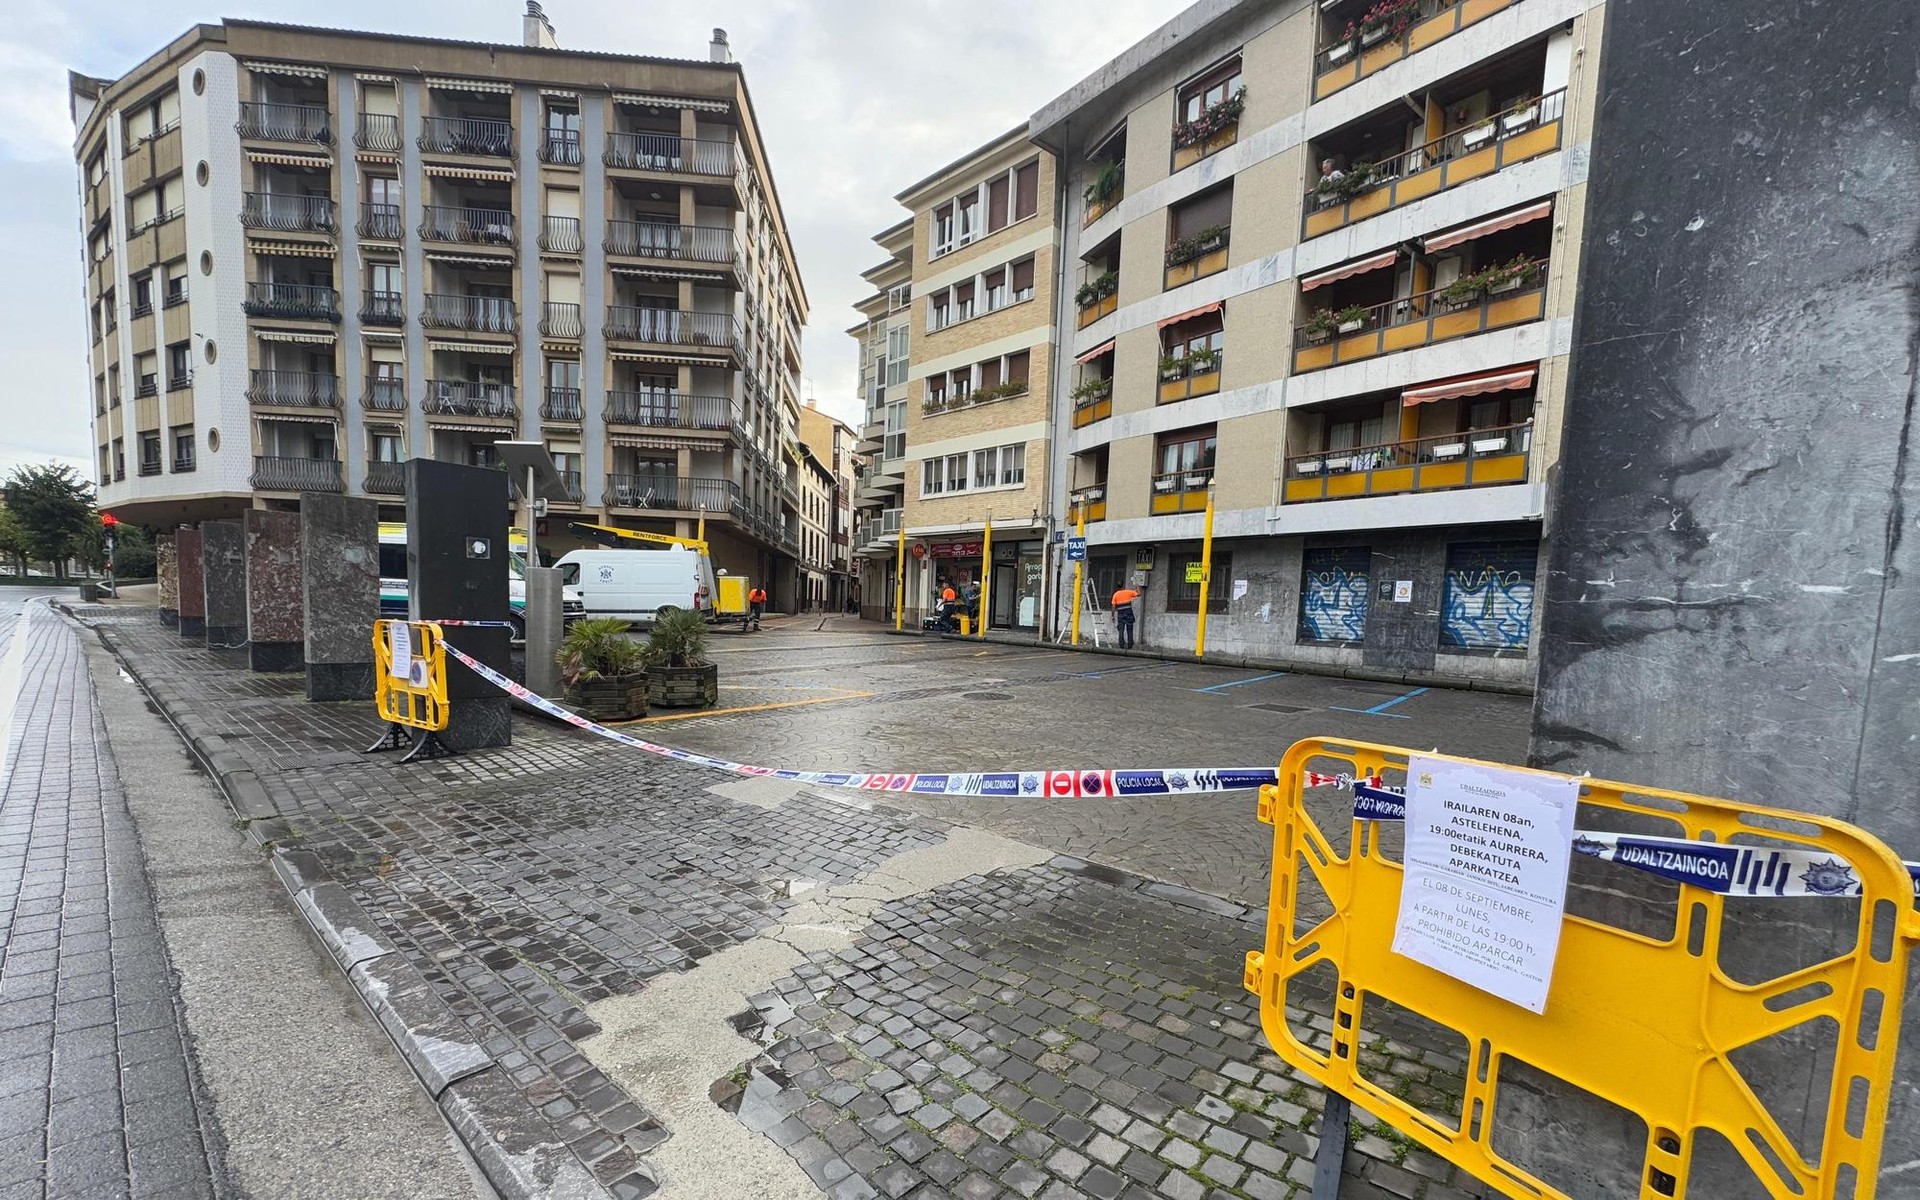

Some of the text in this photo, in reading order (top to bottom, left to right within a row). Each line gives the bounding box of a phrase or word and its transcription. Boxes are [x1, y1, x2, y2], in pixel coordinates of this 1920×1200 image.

[632, 531, 667, 541] RENTFORCE
[1068, 541, 1085, 550] TAXI
[1026, 572, 1042, 585] garb
[1117, 776, 1164, 787] POLICIA LOCAL
[1354, 795, 1375, 811] LOCA
[1444, 800, 1535, 829] IRAILAREN 08an,
[1451, 816, 1524, 841] ASTELEHENA,
[1429, 825, 1548, 863] 19:00etatik AURRERA,
[1450, 844, 1521, 870] DEBEKATUTA
[1449, 858, 1519, 885] APARKATZEA
[1621, 844, 1729, 880] UDALTZAINGOA
[1423, 877, 1534, 924] EL 08 DE SEPTIEMBRE,
[1456, 903, 1491, 924] LUNES,
[1414, 903, 1536, 957] A PARTIR DE LAS 19:00 h,
[1418, 919, 1471, 946] PROHIBIDO
[1472, 941, 1524, 967] APARCAR
